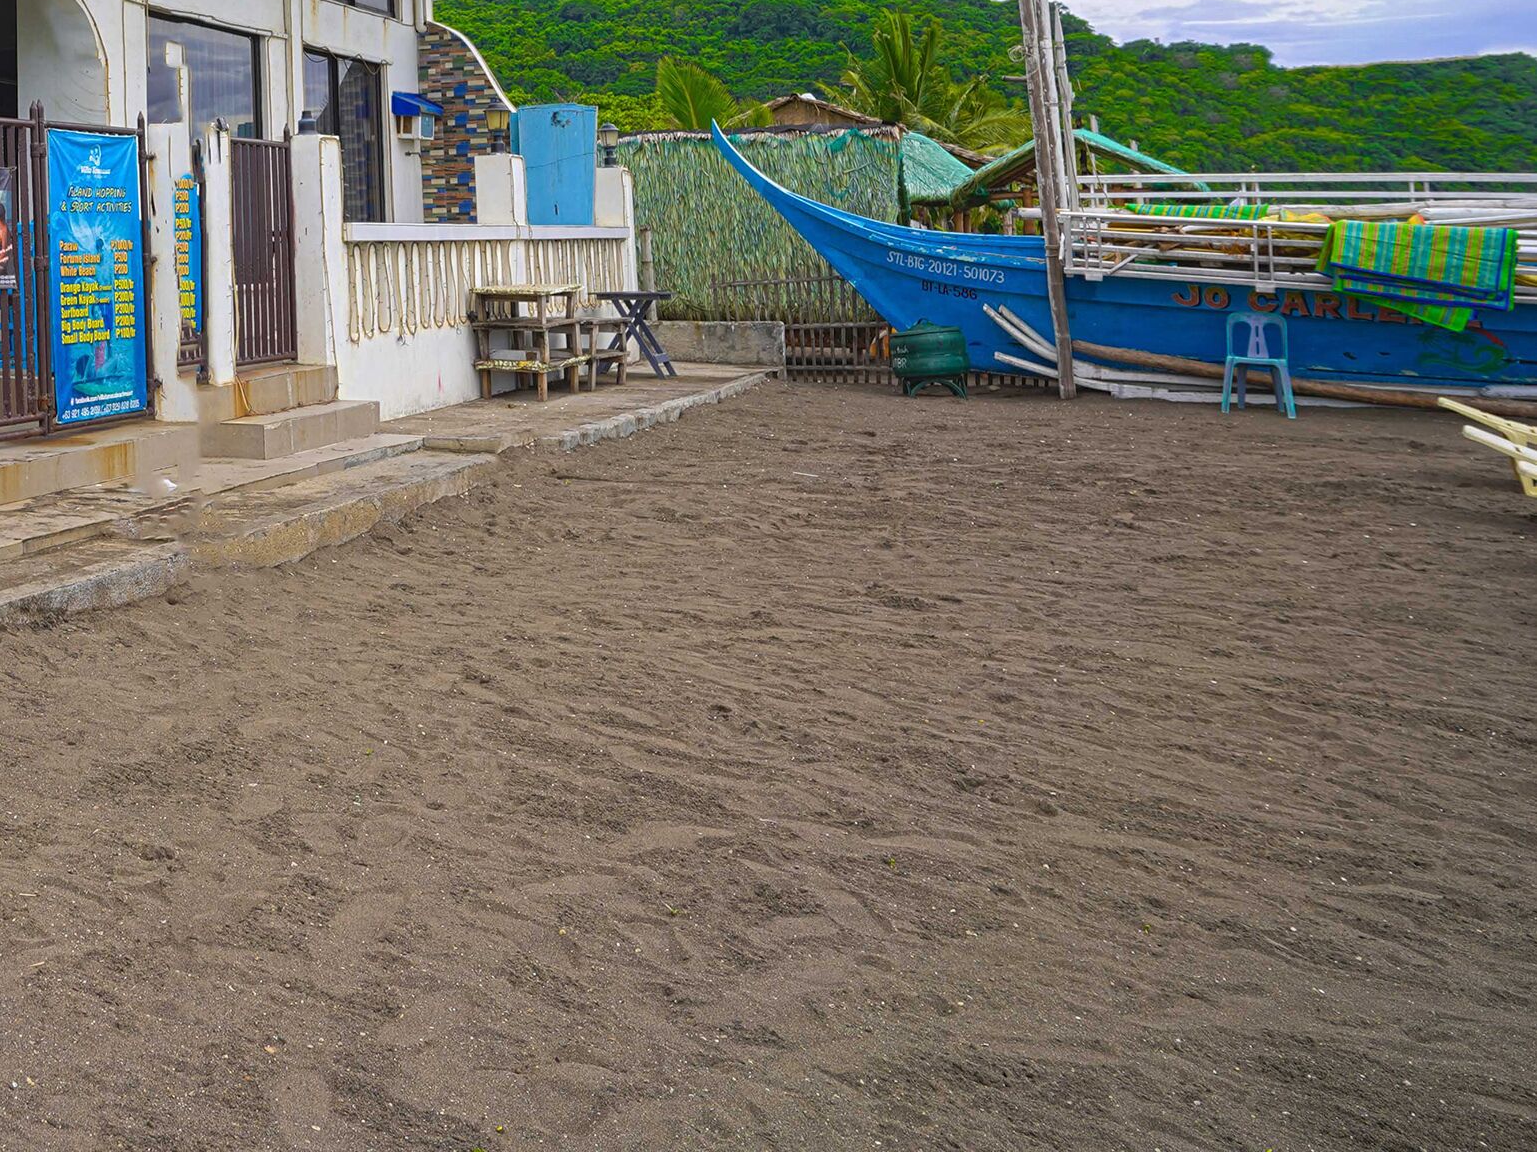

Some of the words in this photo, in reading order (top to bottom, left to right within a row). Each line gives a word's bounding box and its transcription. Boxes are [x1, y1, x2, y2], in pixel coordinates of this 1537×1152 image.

[95, 186, 127, 198] HOPPING
[70, 201, 94, 213] SPORT
[59, 239, 78, 251] Paraw
[60, 252, 82, 264] Fortune
[60, 265, 78, 277] White
[78, 265, 96, 276] Beach
[81, 281, 99, 294] Kayak
[60, 294, 78, 306] Green
[78, 293, 96, 306] Kayak
[1171, 284, 1231, 309] JO
[78, 331, 93, 344] Body
